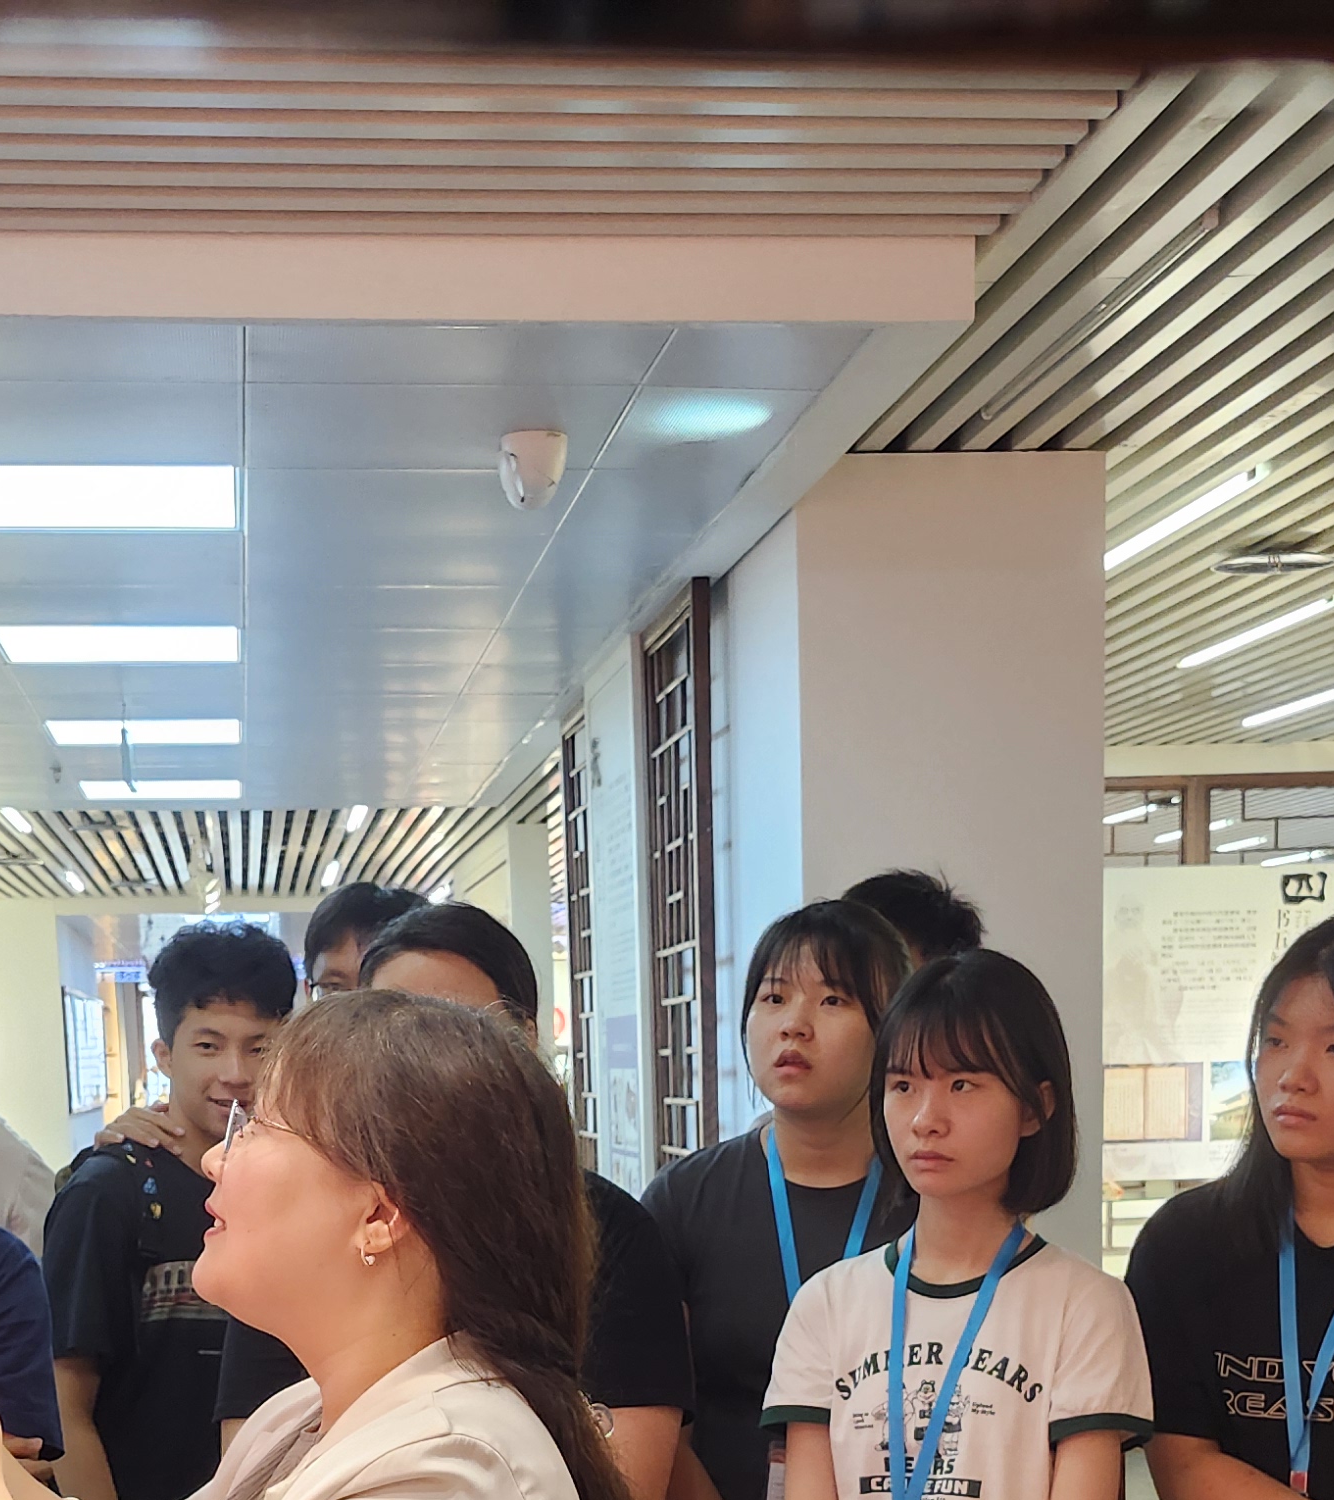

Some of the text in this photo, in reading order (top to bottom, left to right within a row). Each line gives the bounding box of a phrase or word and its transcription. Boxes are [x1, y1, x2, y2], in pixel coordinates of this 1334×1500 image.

[835, 1342, 1043, 1403] SUMER EARS
[883, 1456, 956, 1476] ERS
